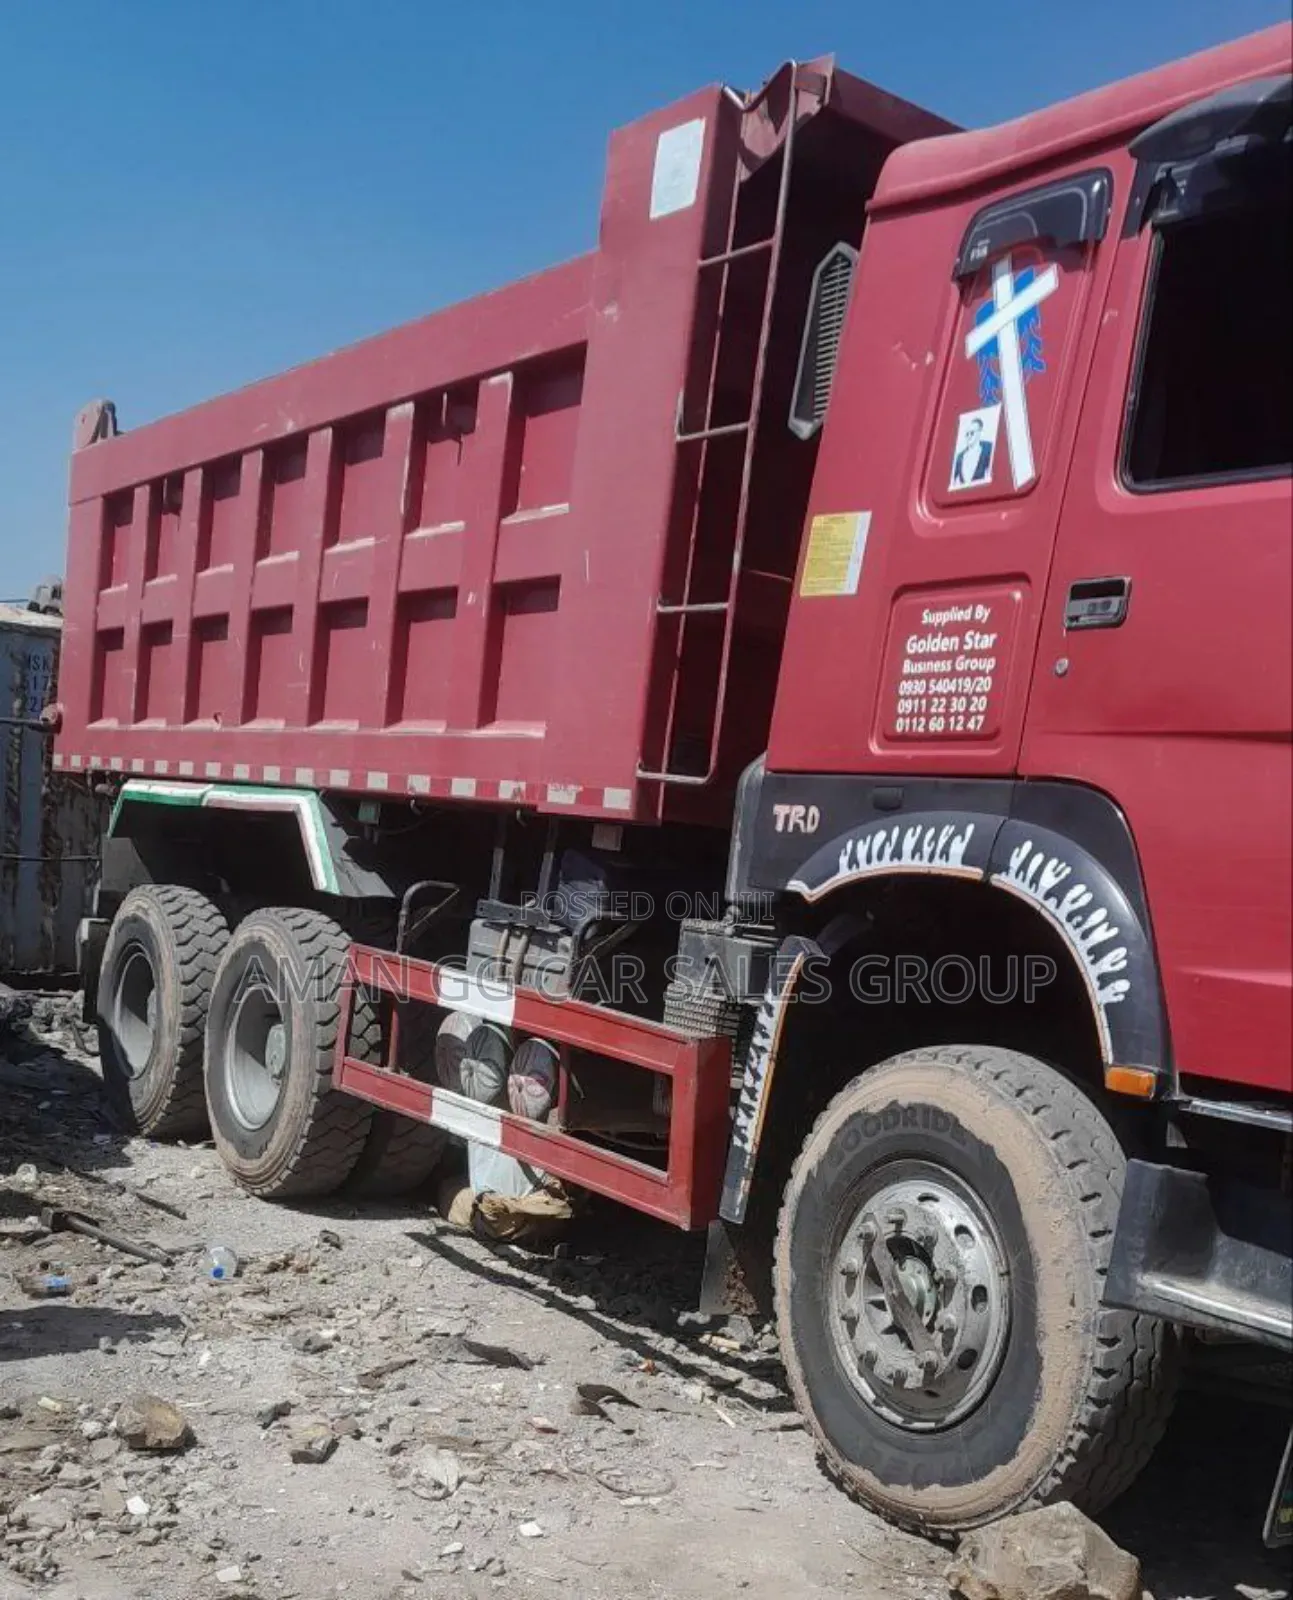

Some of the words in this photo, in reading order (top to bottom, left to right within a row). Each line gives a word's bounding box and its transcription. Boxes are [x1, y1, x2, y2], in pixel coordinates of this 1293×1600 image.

[922, 605, 973, 627] Supplied
[975, 604, 991, 624] By
[906, 632, 960, 654] Golden
[963, 630, 998, 650] Star
[902, 659, 953, 674] Business
[955, 655, 997, 674] Group
[899, 679, 926, 696] 0930
[897, 698, 926, 714] 0911
[930, 697, 946, 713] 22
[949, 696, 967, 713] 30
[969, 695, 987, 712] 20
[896, 716, 926, 733] 0112
[928, 716, 945, 732] 60
[949, 715, 964, 731] 12
[966, 714, 985, 731] 47
[773, 804, 820, 833] TRD
